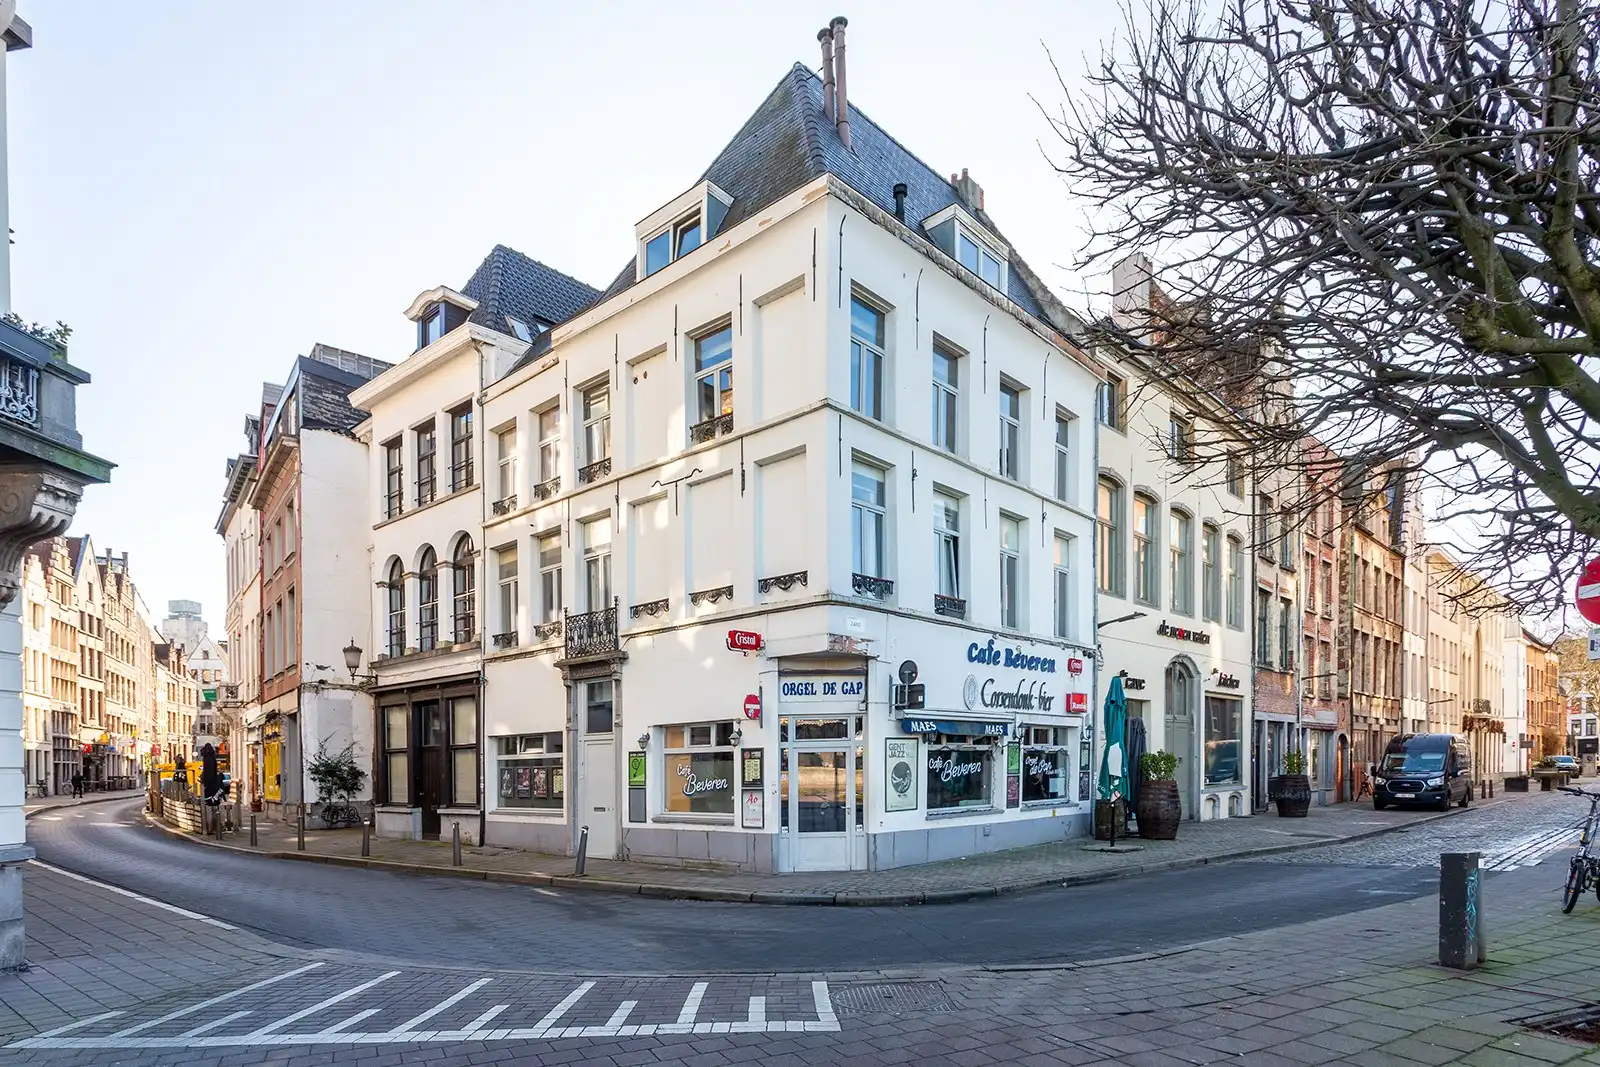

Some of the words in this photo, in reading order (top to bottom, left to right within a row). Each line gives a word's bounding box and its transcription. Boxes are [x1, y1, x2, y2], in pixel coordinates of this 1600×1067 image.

[735, 632, 756, 646] Cristal
[1003, 647, 1056, 673] Beveren
[782, 682, 817, 696] ORGEL
[822, 682, 837, 696] DE
[911, 721, 937, 732] MAES
[984, 725, 1003, 735] MAES
[888, 743, 906, 751] GENT
[888, 751, 906, 759] JAZZ
[941, 760, 981, 781] Beveren
[683, 773, 728, 795] Beveren
